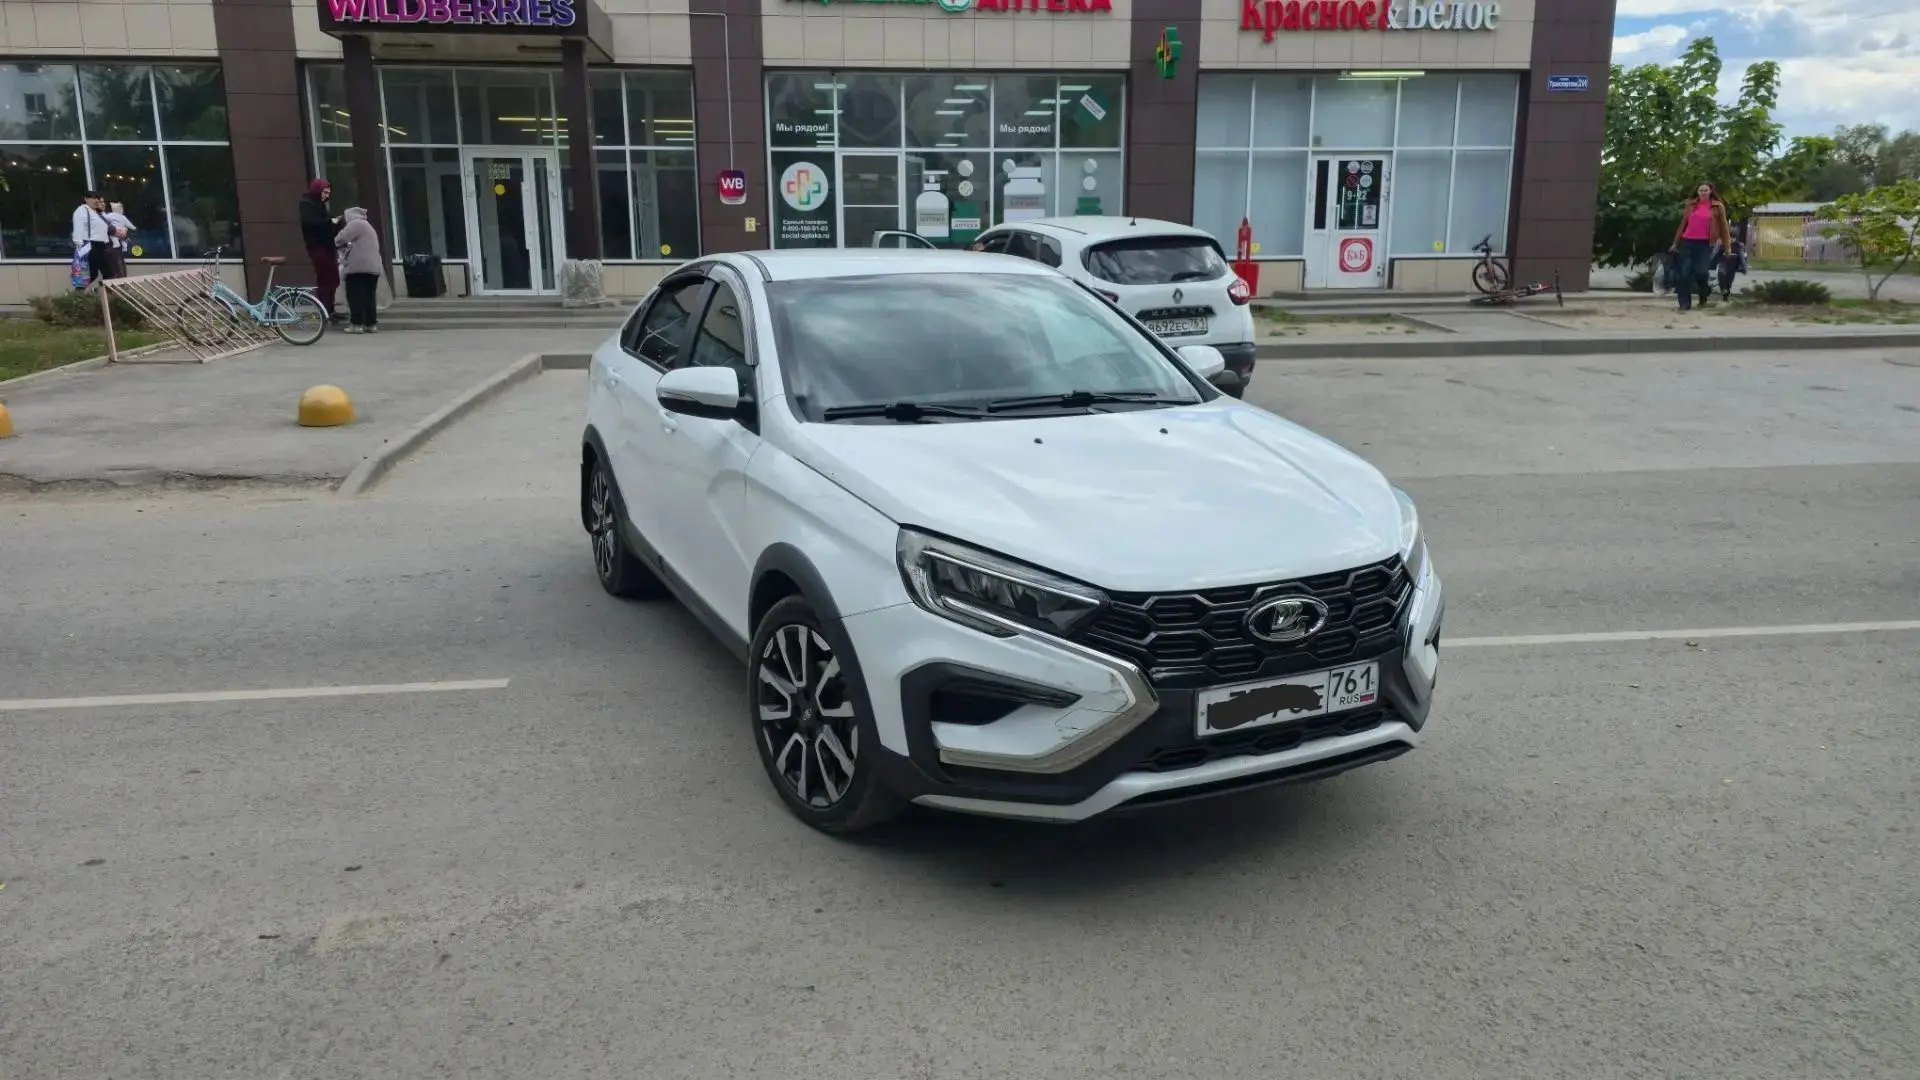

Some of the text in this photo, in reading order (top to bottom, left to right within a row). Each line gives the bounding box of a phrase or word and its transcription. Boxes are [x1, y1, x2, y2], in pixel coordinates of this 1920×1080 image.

[328, 0, 576, 26] WILDBERRIES
[776, 123, 828, 134] Мы рядом!
[1000, 124, 1051, 134] Мы рядом!
[721, 177, 744, 189] WB
[1332, 665, 1372, 698] 761
[1339, 695, 1360, 706] RUS
